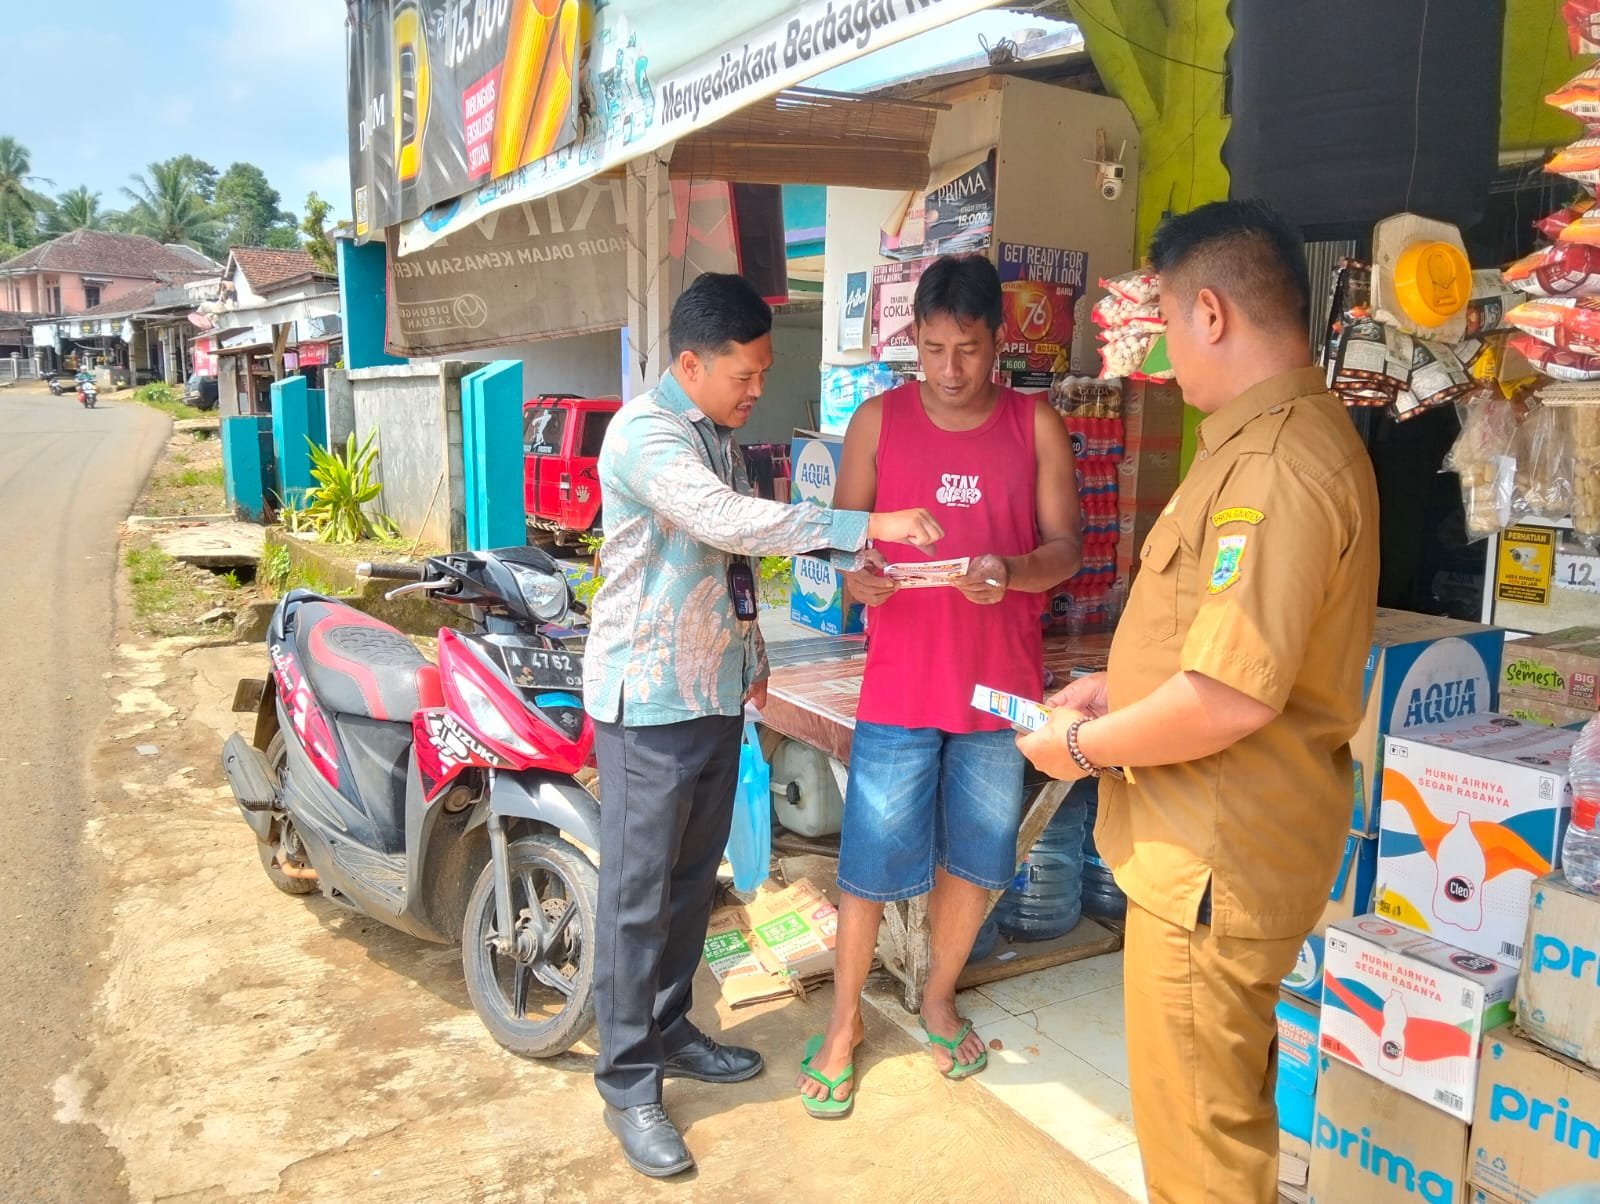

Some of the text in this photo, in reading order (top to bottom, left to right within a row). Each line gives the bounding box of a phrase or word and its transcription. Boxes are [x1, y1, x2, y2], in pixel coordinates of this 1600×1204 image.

[661, 0, 897, 125] Menyediakan Berbagai
[937, 171, 987, 208] PRIMA
[1004, 244, 1083, 269] GET READY FOR
[1028, 265, 1083, 287] NEW LOOK
[883, 304, 914, 318] COKLAT
[1021, 295, 1047, 333] 76
[1002, 342, 1032, 354] APEL
[801, 463, 831, 488] AQUA
[941, 473, 979, 490] STAY
[1508, 531, 1547, 543] PERHATIAN
[800, 559, 831, 585] AQUA
[1567, 562, 1596, 586] 12
[511, 650, 522, 667] A
[1506, 663, 1595, 690] Semesta BIG
[1403, 677, 1477, 729] AQUA
[442, 713, 499, 767] SUZUKI
[1418, 777, 1510, 809] SEGAR RASANYA
[1425, 767, 1504, 795] MURNI AIRNYA
[1450, 881, 1470, 899] Cleo
[731, 936, 741, 946] 3
[1355, 962, 1443, 1003] SEGAR RASANYA
[1361, 951, 1437, 988] MURNI AIRNYA
[1316, 1112, 1454, 1204] prima
